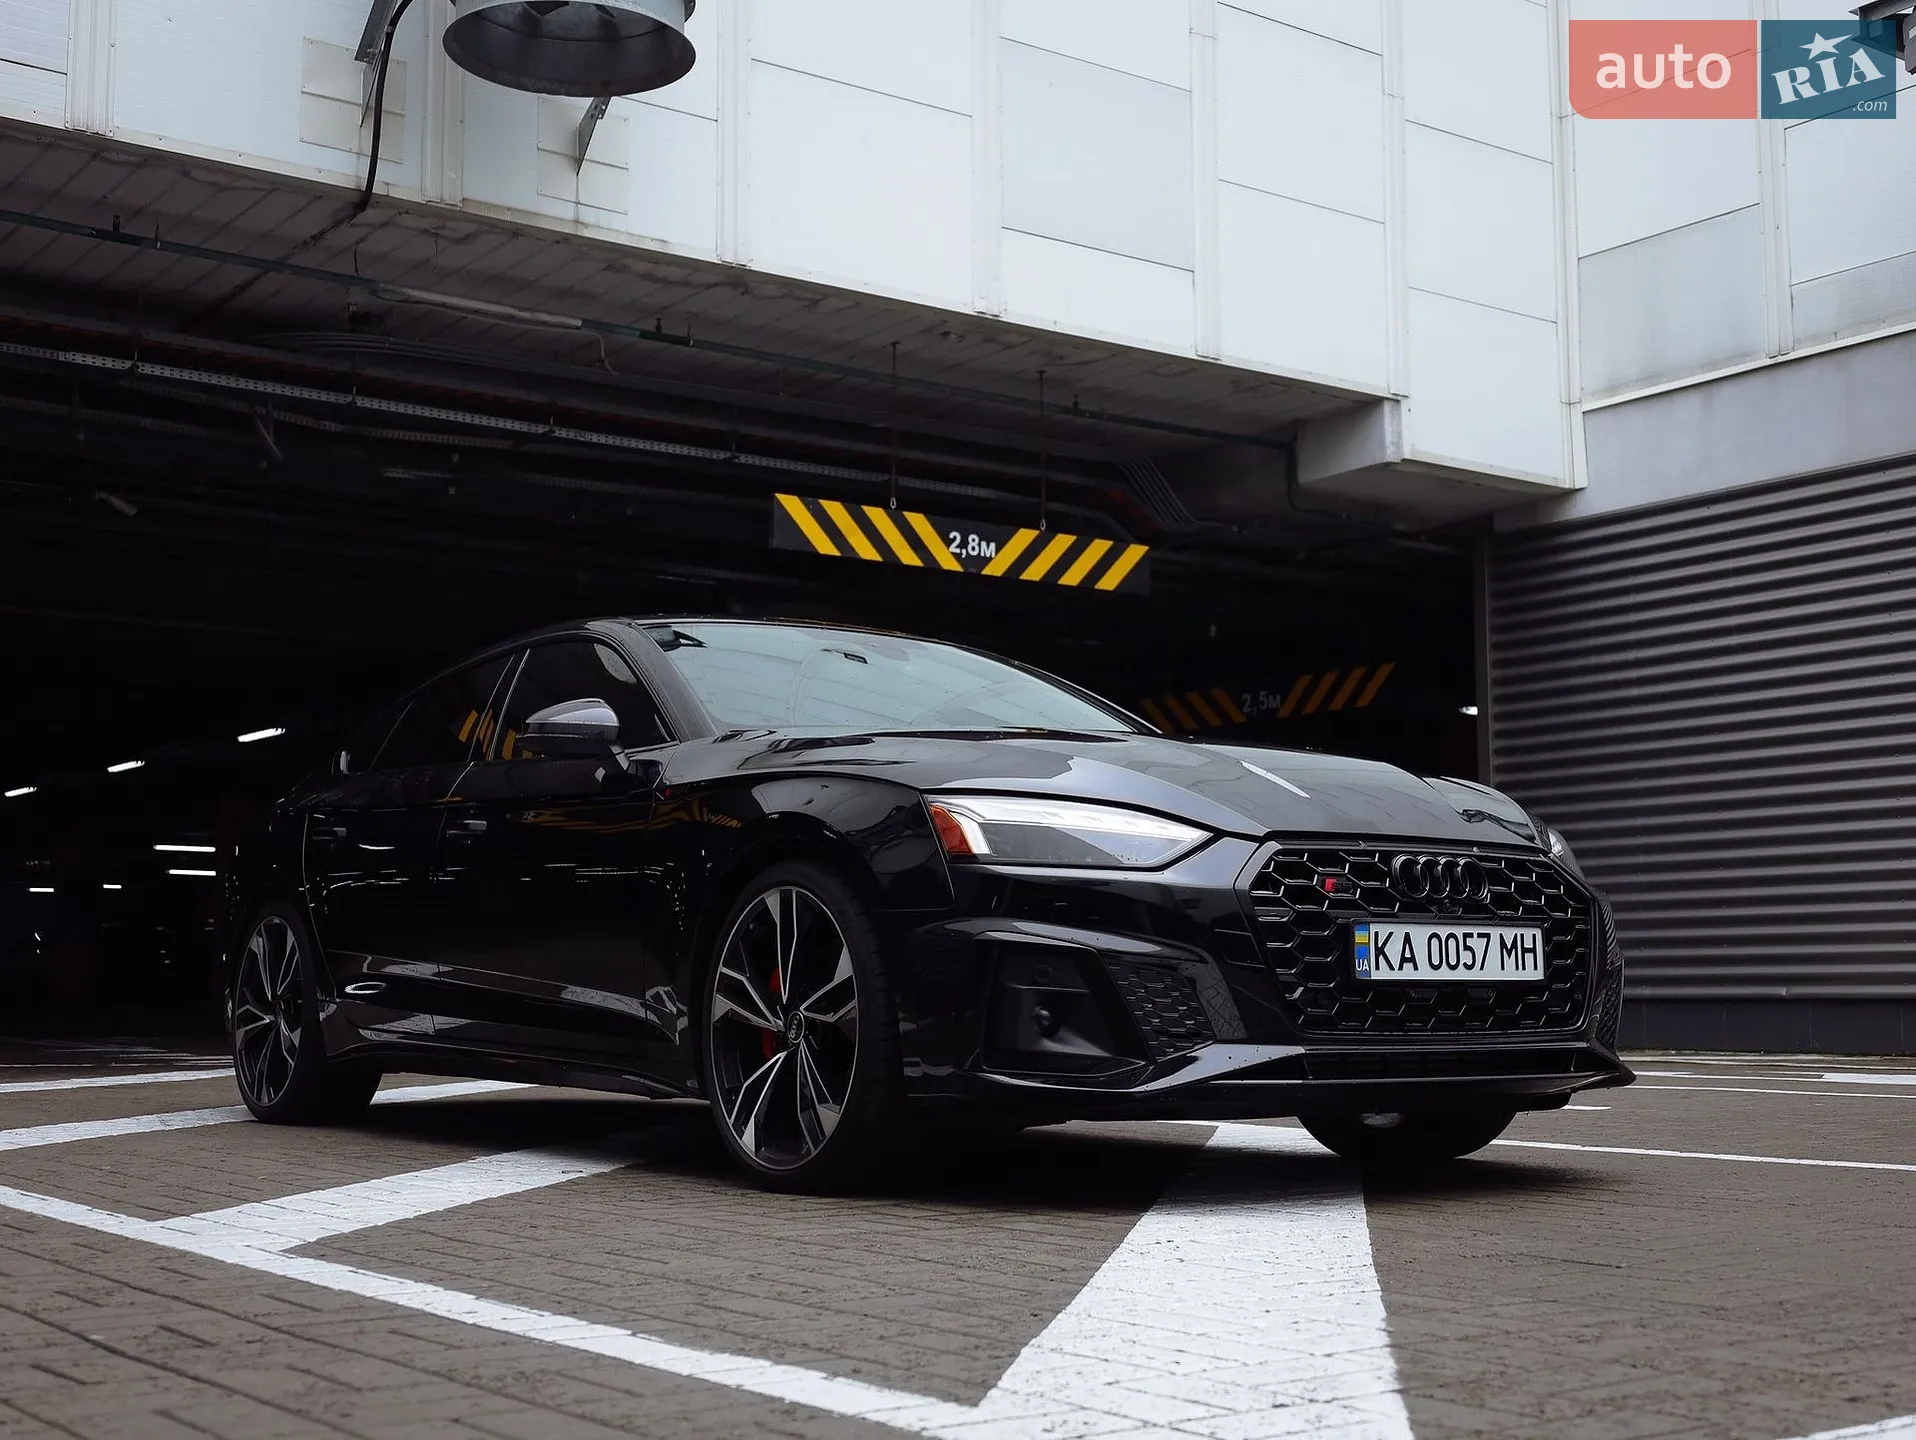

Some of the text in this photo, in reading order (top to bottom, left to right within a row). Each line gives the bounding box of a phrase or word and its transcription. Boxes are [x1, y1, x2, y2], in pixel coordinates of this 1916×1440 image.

[1355, 958, 1370, 972] UA
[1373, 930, 1539, 972] KA 0057 MH
